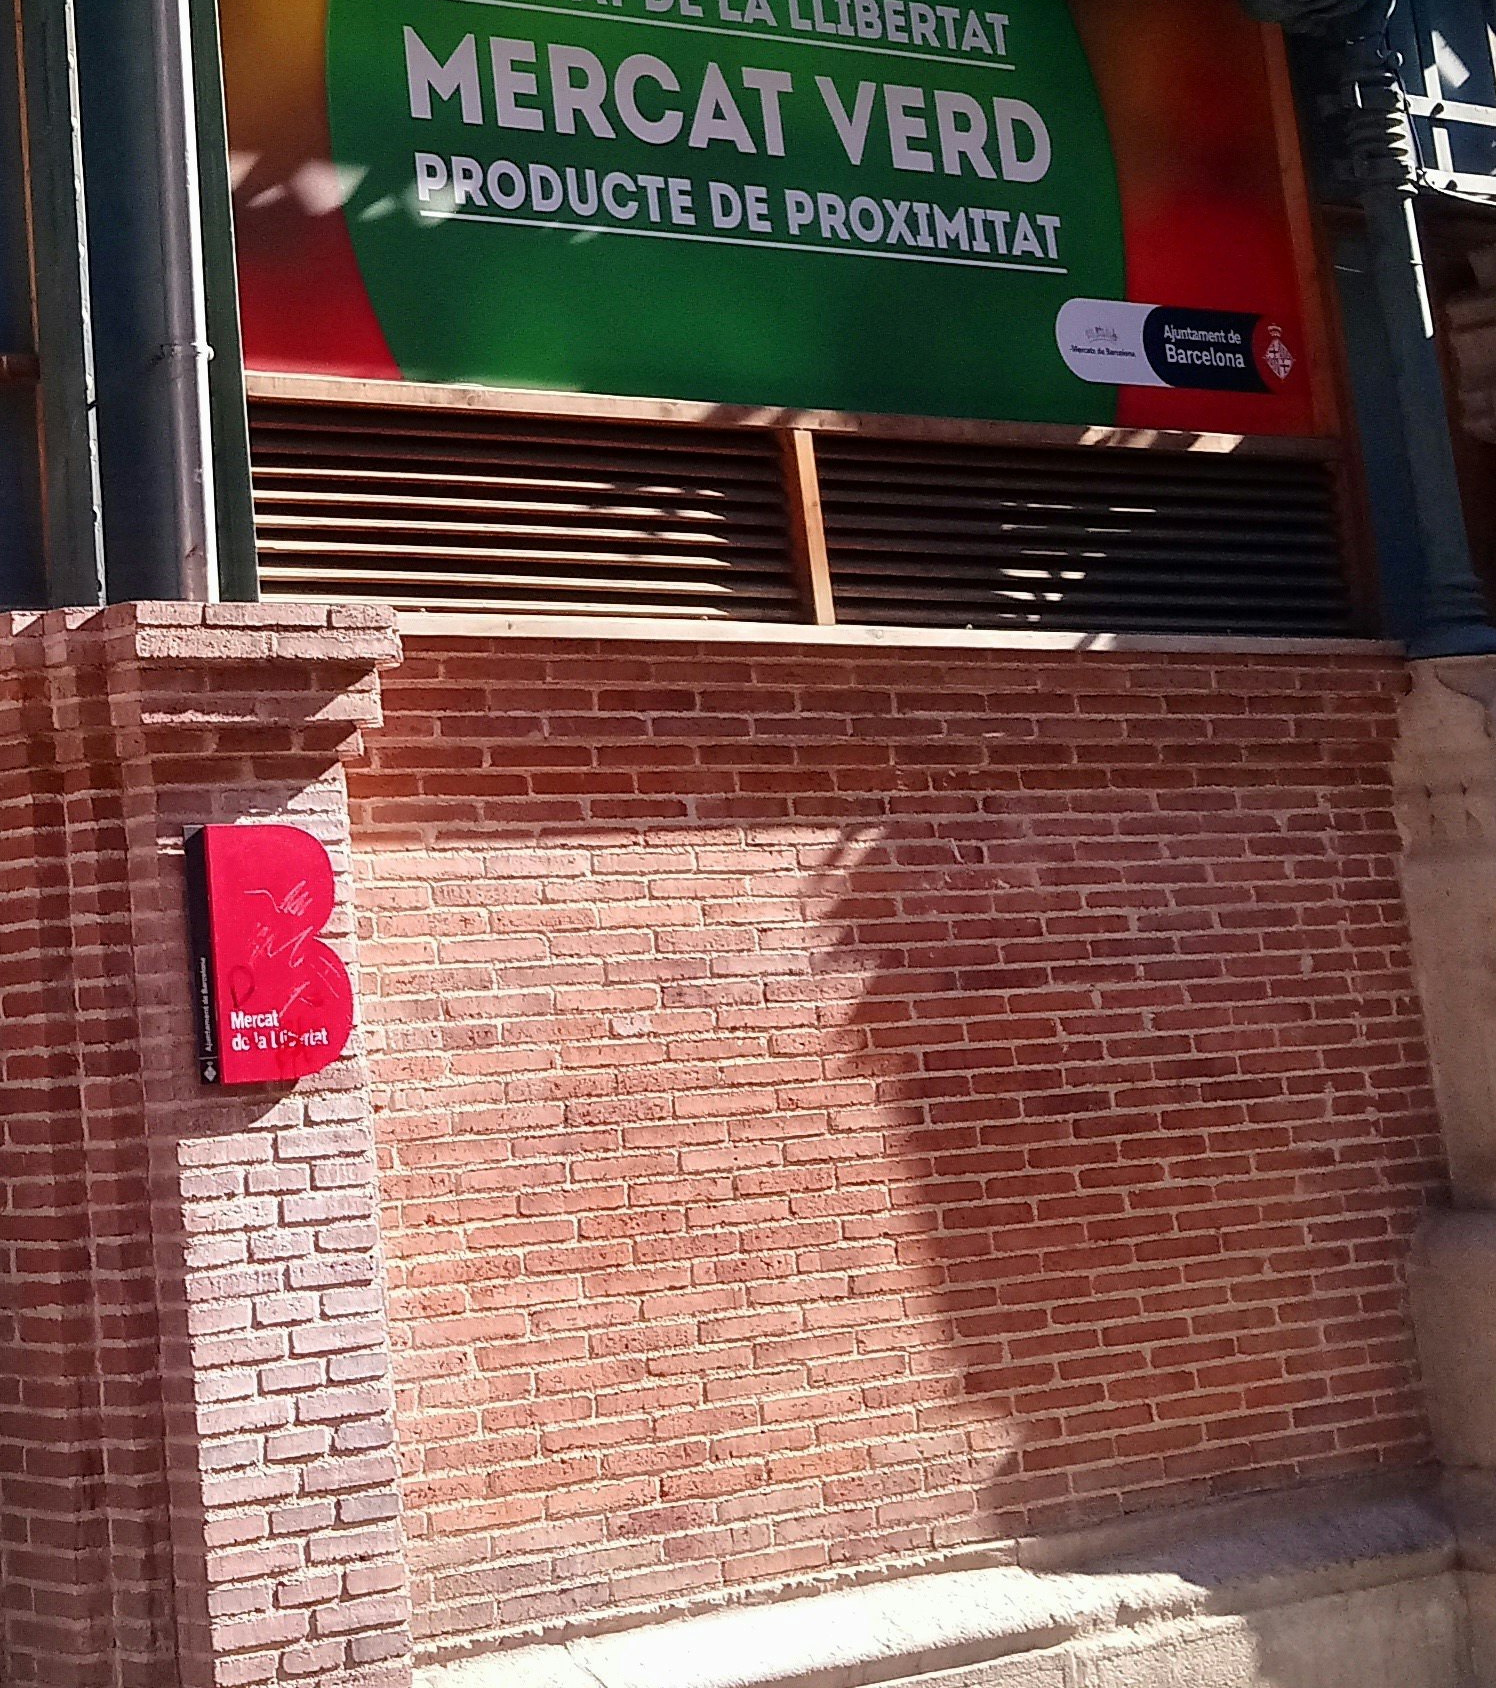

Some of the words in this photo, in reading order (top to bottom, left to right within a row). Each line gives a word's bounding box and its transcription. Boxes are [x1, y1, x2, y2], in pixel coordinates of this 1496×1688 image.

[403, 26, 793, 157] MERCAT
[815, 76, 1052, 183] VERD
[414, 152, 696, 226] PRODUCTE
[708, 181, 773, 233] DE
[785, 190, 1061, 259] PROXIMITAT
[1163, 324, 1226, 344] Ajuntament
[1227, 329, 1242, 344] de
[1165, 344, 1246, 368] Barcelona
[230, 1009, 279, 1030] Mercat
